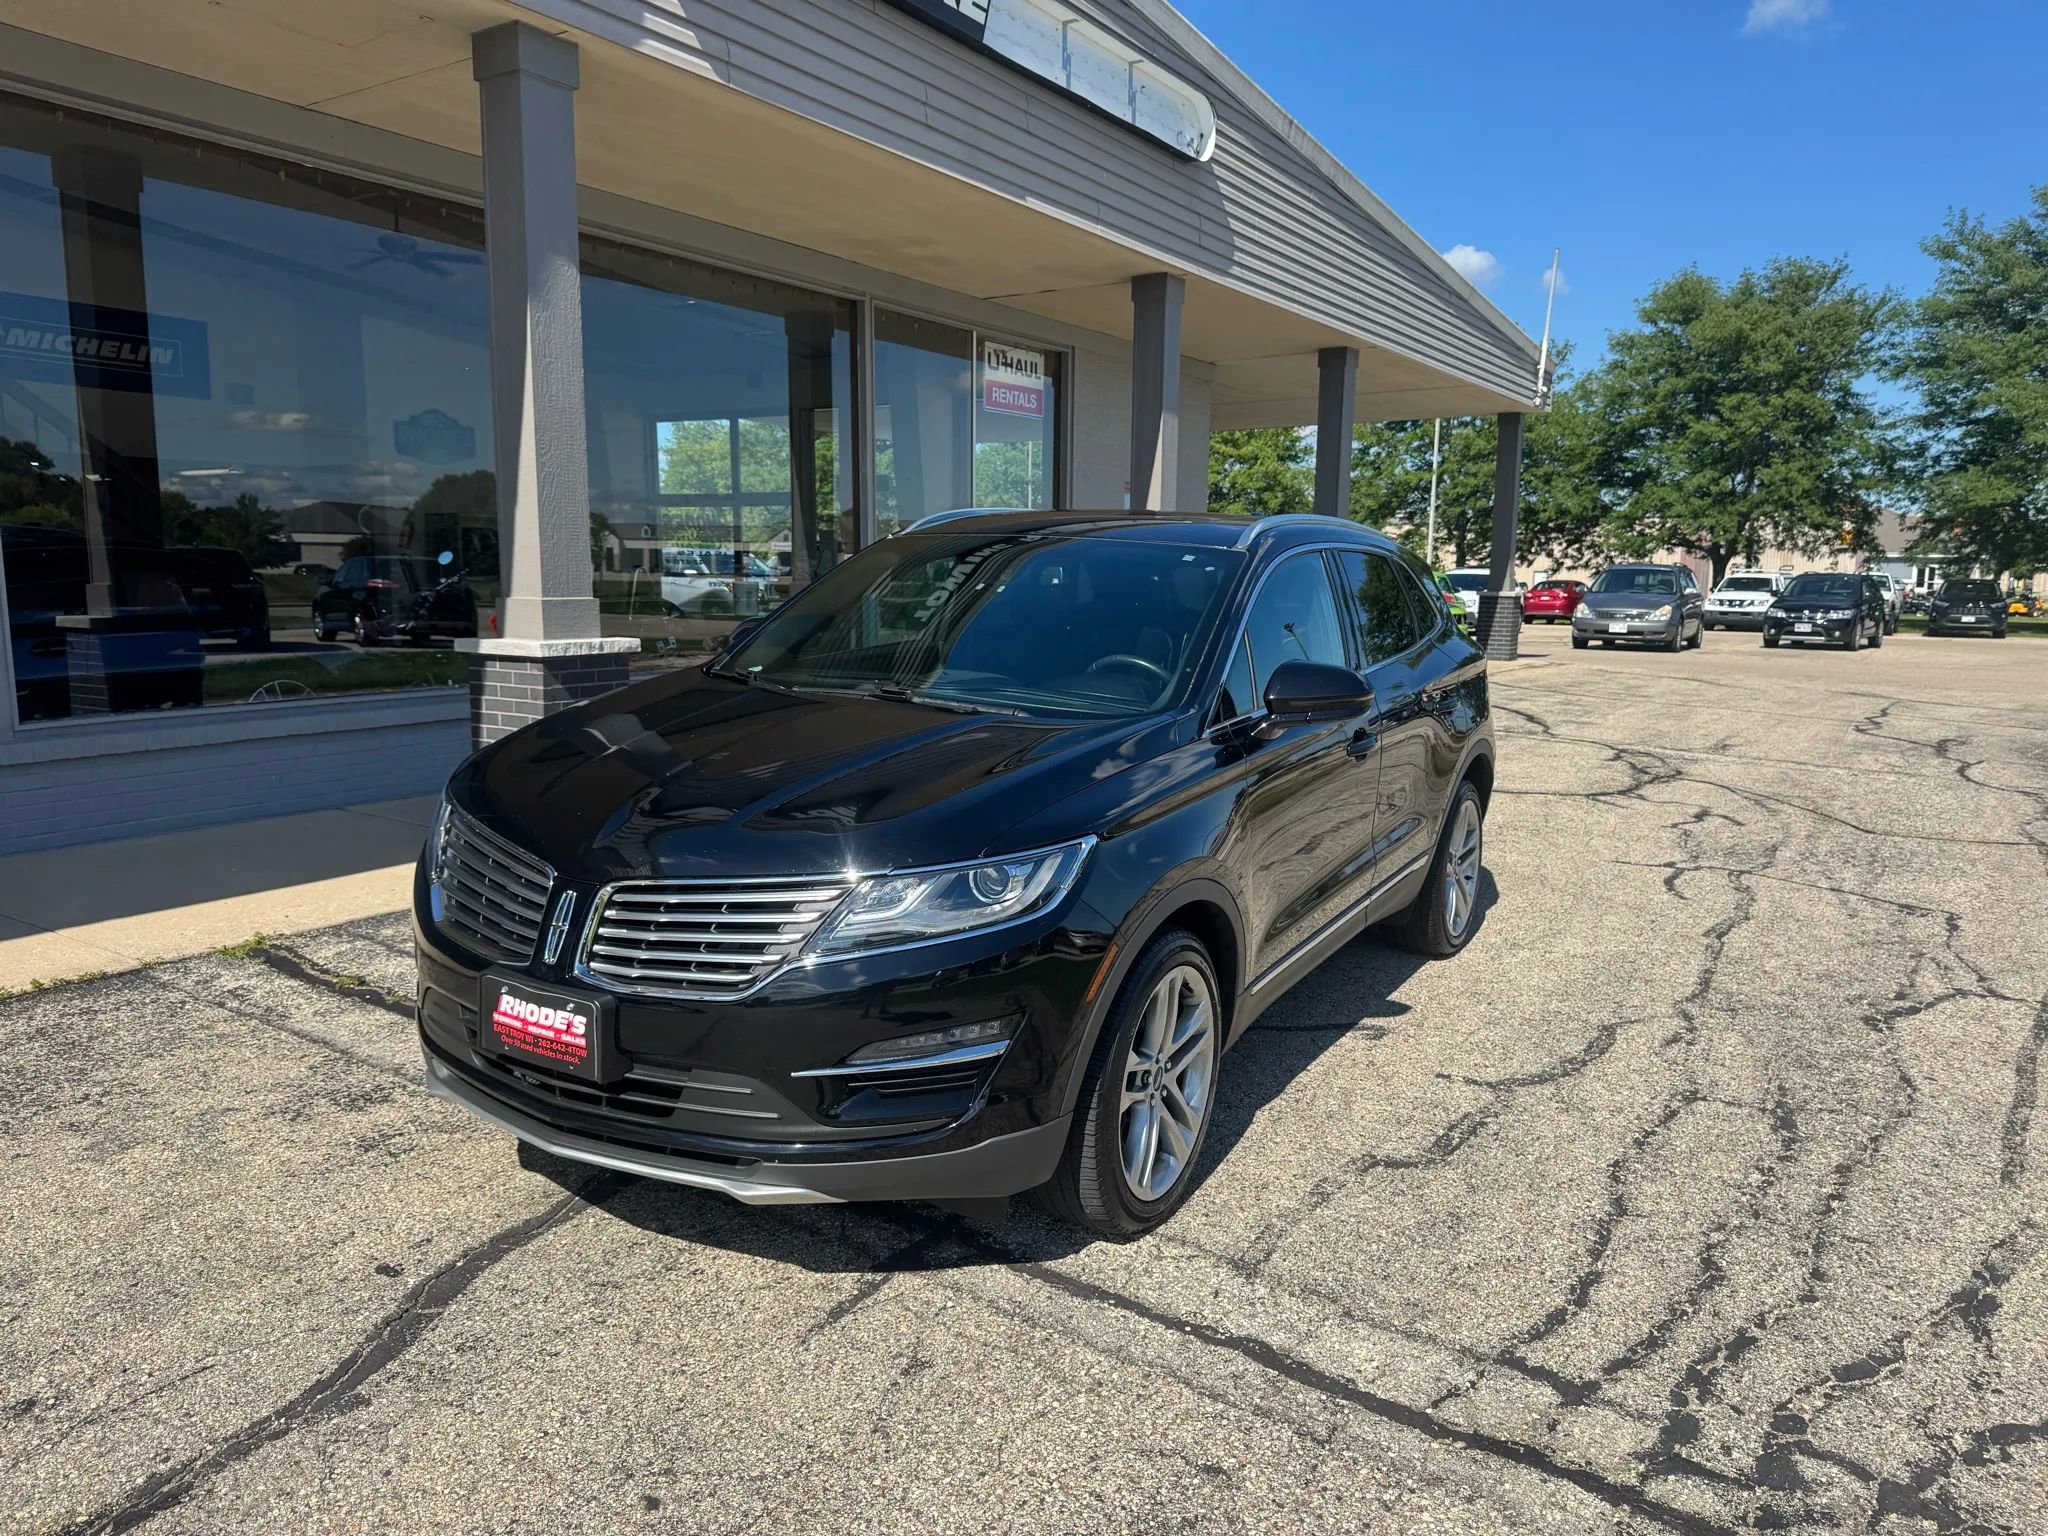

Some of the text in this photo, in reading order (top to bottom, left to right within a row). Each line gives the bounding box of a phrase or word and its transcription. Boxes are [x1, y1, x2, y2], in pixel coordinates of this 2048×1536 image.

[6, 328, 175, 365] MICHELIN
[992, 387, 1037, 408] RENTALS
[499, 994, 587, 1036] RHODE'S
[538, 1038, 588, 1057] 262-642-4TOW
[561, 1033, 586, 1046] SALES
[534, 1046, 556, 1058] vehicles
